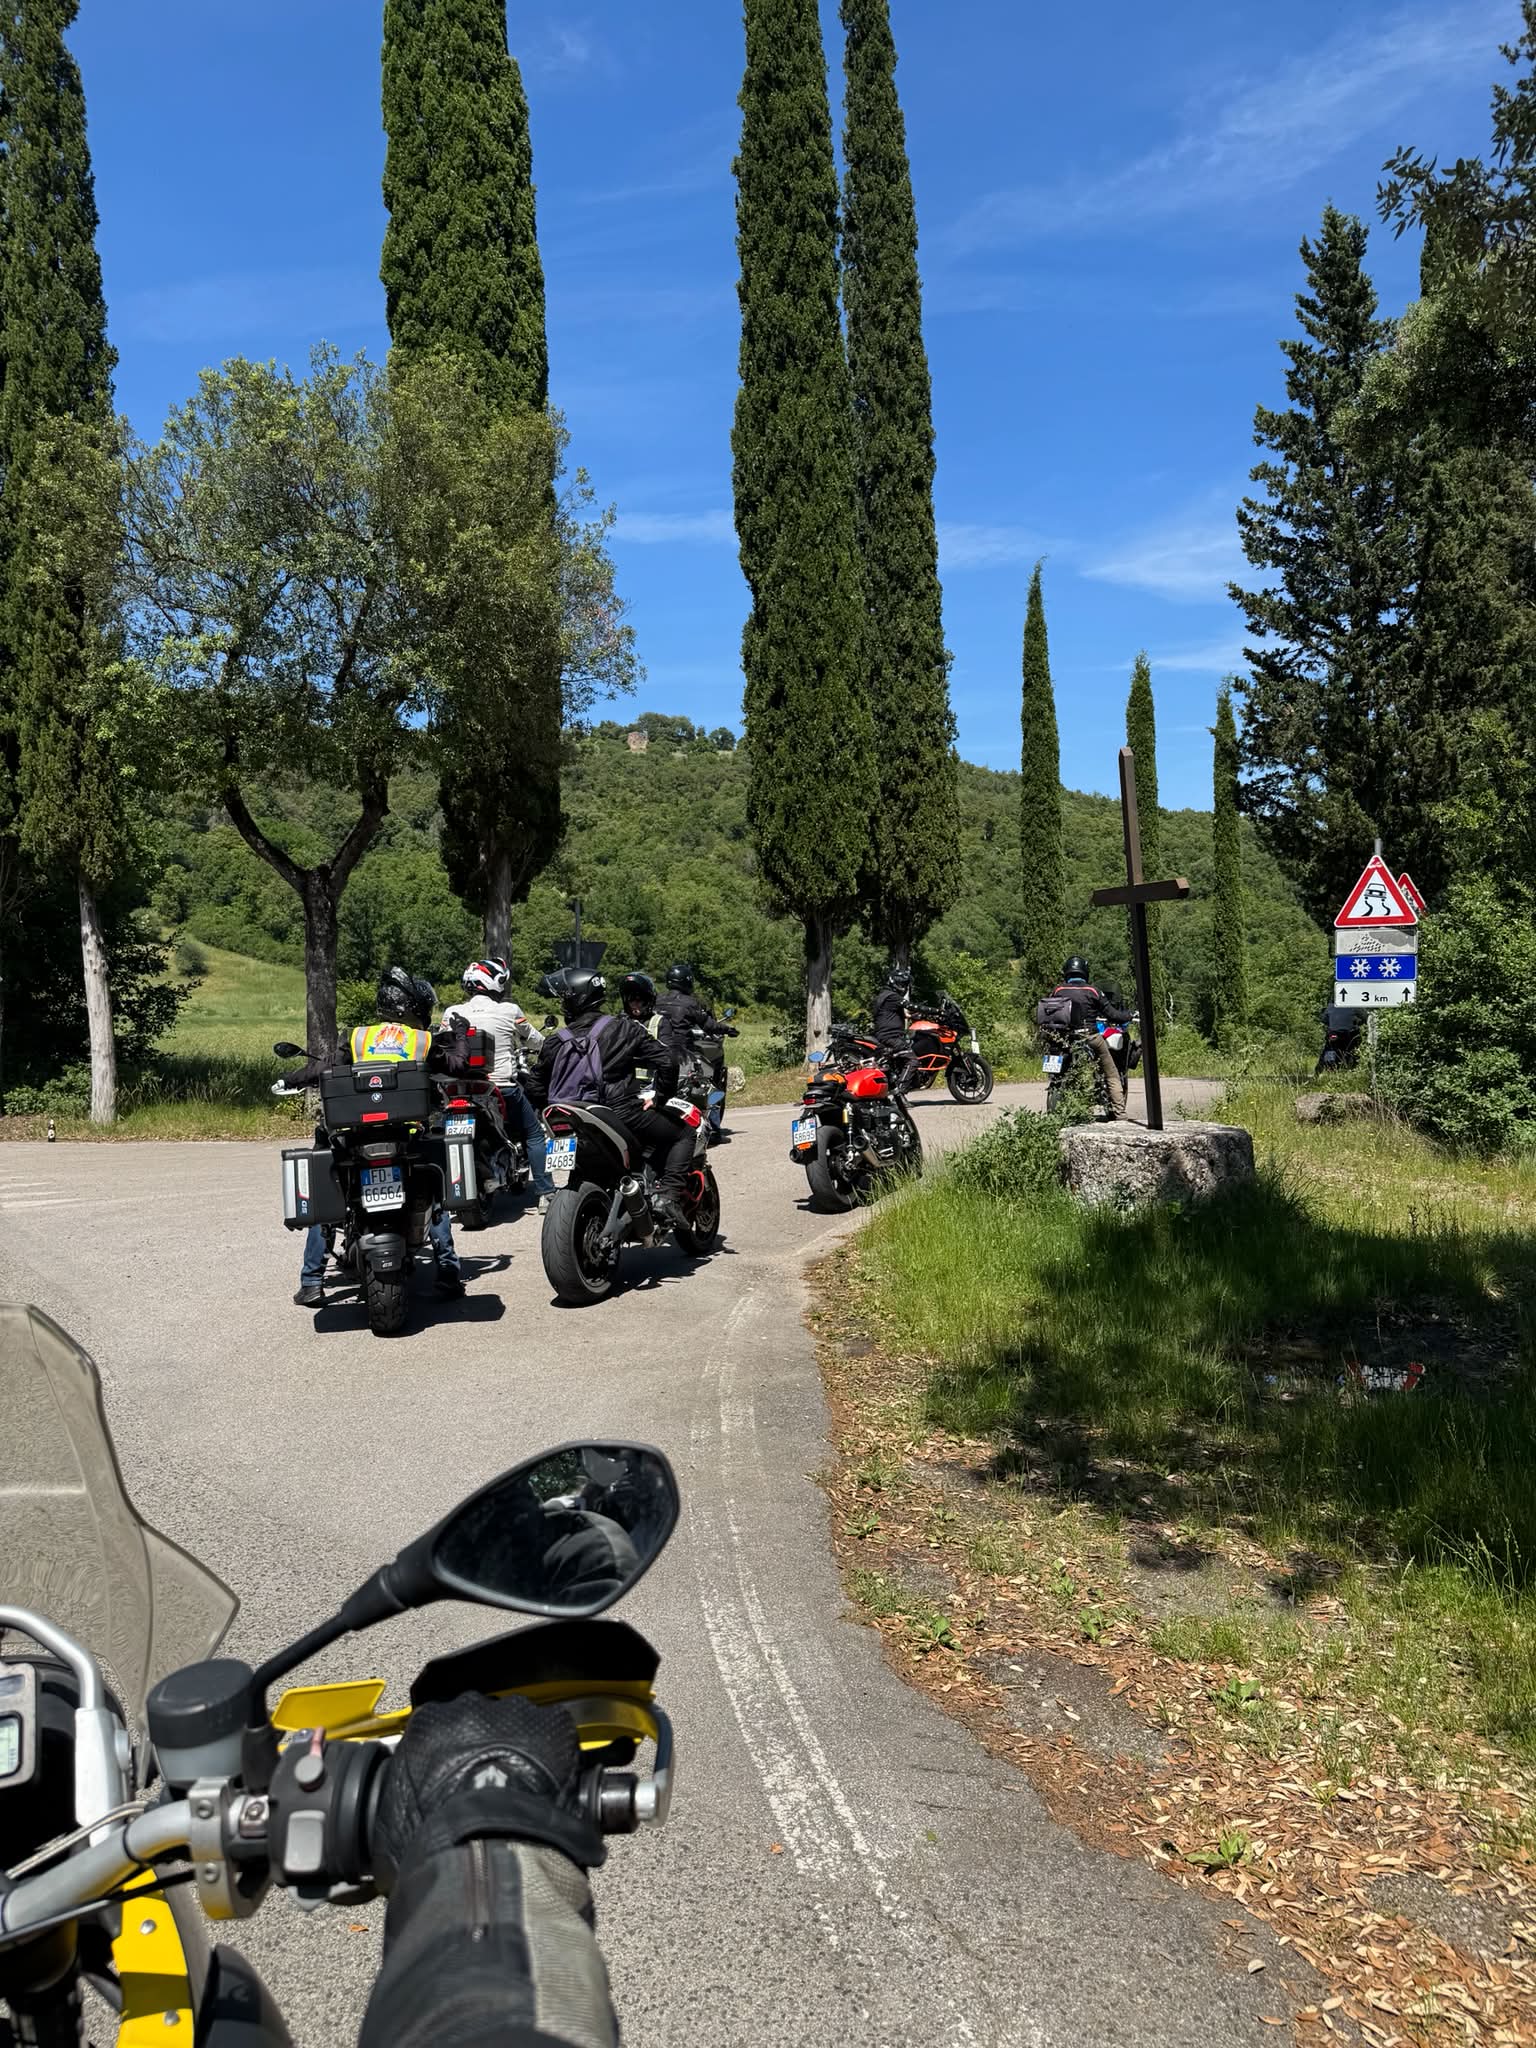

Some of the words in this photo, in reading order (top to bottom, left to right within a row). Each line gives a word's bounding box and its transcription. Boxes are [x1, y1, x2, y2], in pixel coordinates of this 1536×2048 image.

[1361, 991, 1370, 1002] 3
[1374, 994, 1388, 1002] km
[547, 1154, 574, 1169] 94683
[365, 1184, 402, 1202] 66564
